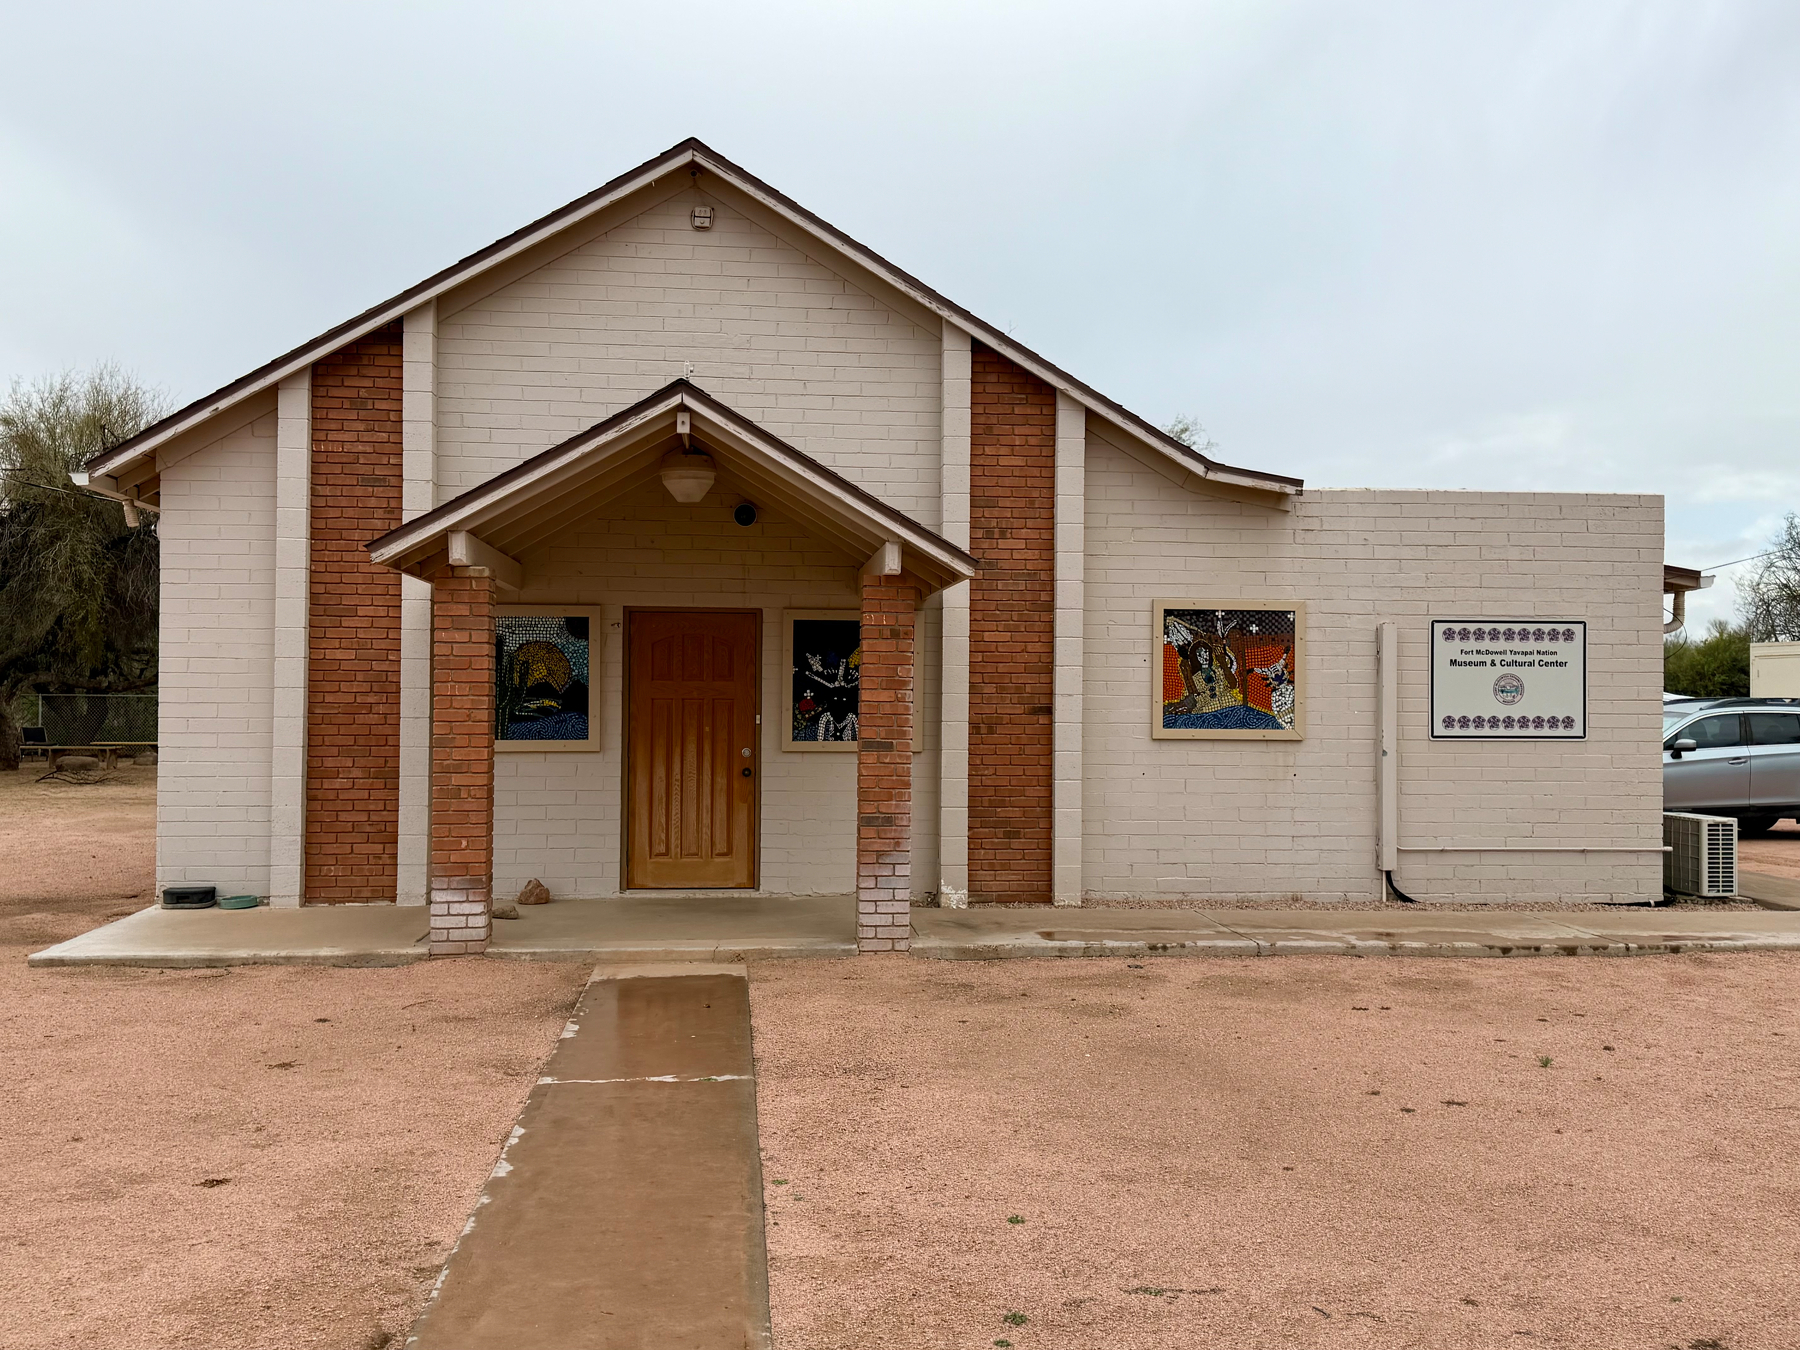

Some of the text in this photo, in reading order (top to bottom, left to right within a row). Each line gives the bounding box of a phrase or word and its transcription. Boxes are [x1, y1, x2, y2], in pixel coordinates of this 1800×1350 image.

[1509, 649, 1535, 657] Yavapai
[1449, 659, 1569, 667] Museum & Cultural Center
